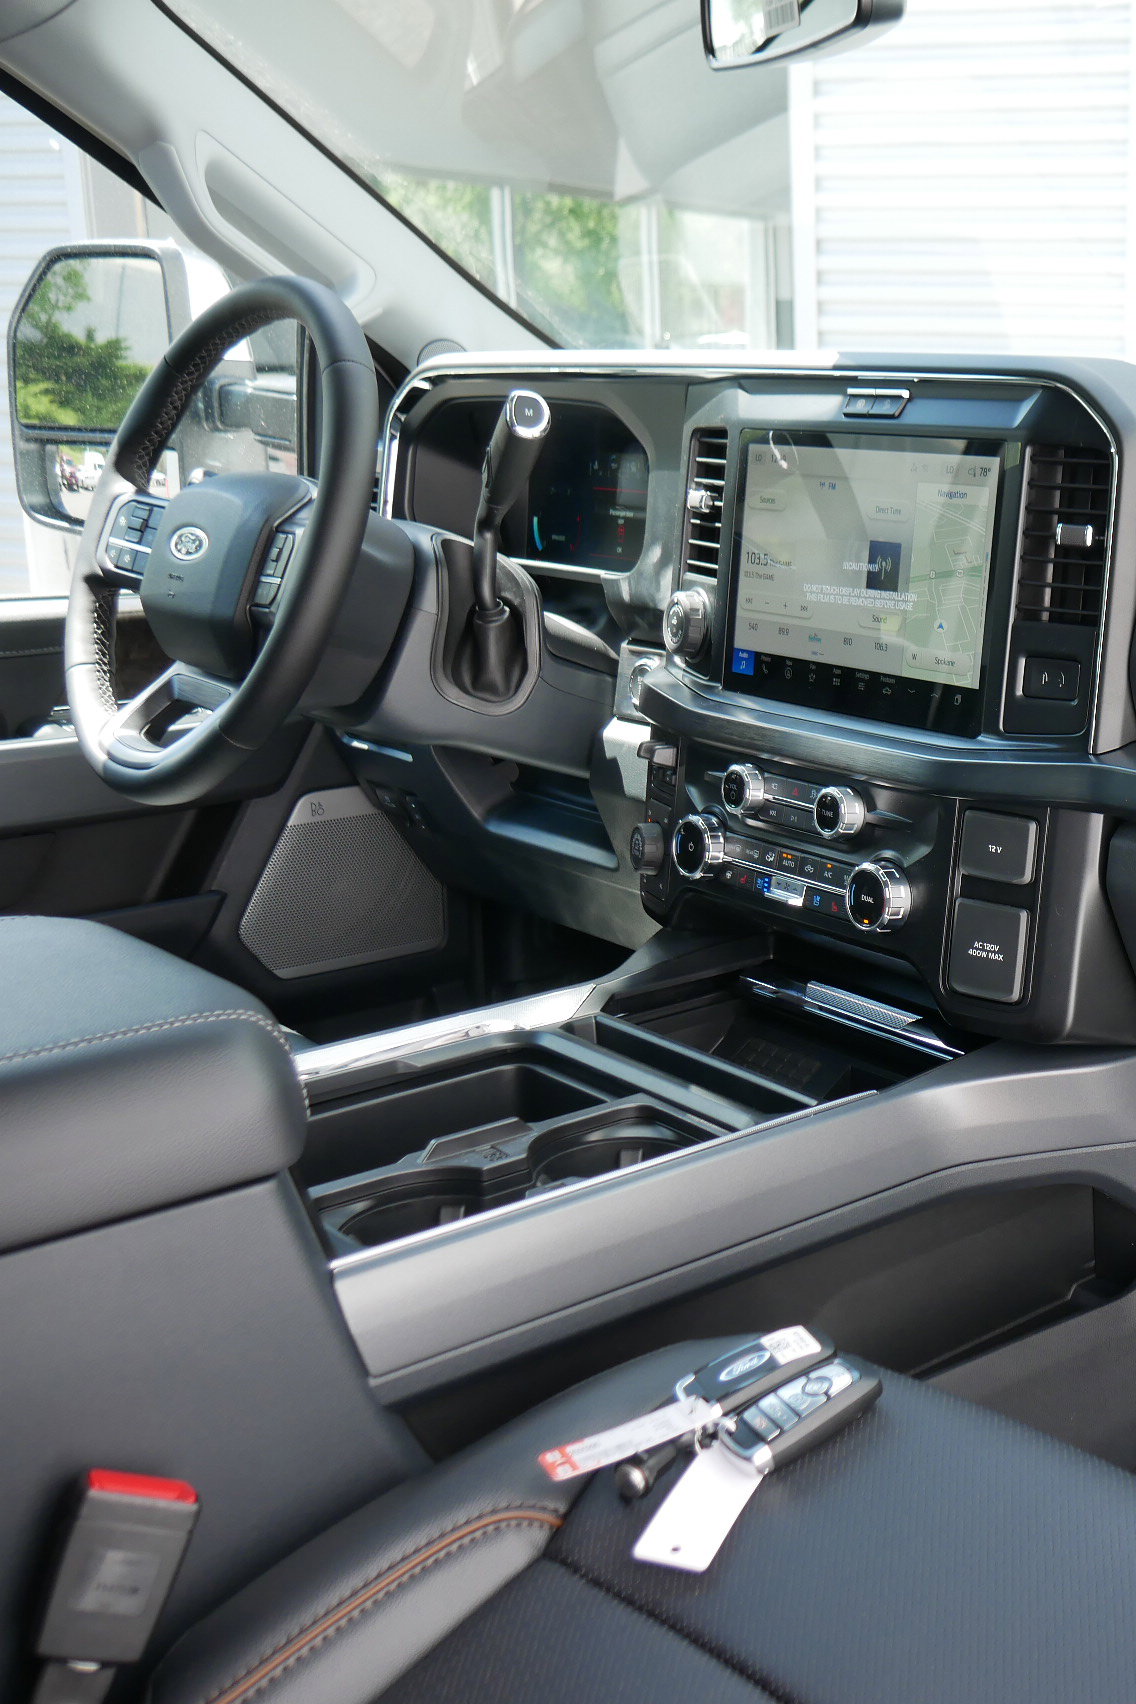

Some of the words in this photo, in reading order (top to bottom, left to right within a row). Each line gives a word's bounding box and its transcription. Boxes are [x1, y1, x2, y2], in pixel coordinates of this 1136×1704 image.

[937, 489, 968, 500] Navigation
[746, 551, 769, 566] 103.5
[934, 656, 956, 667] Spokane
[968, 949, 988, 959] 400W
[988, 951, 1004, 962] MAX
